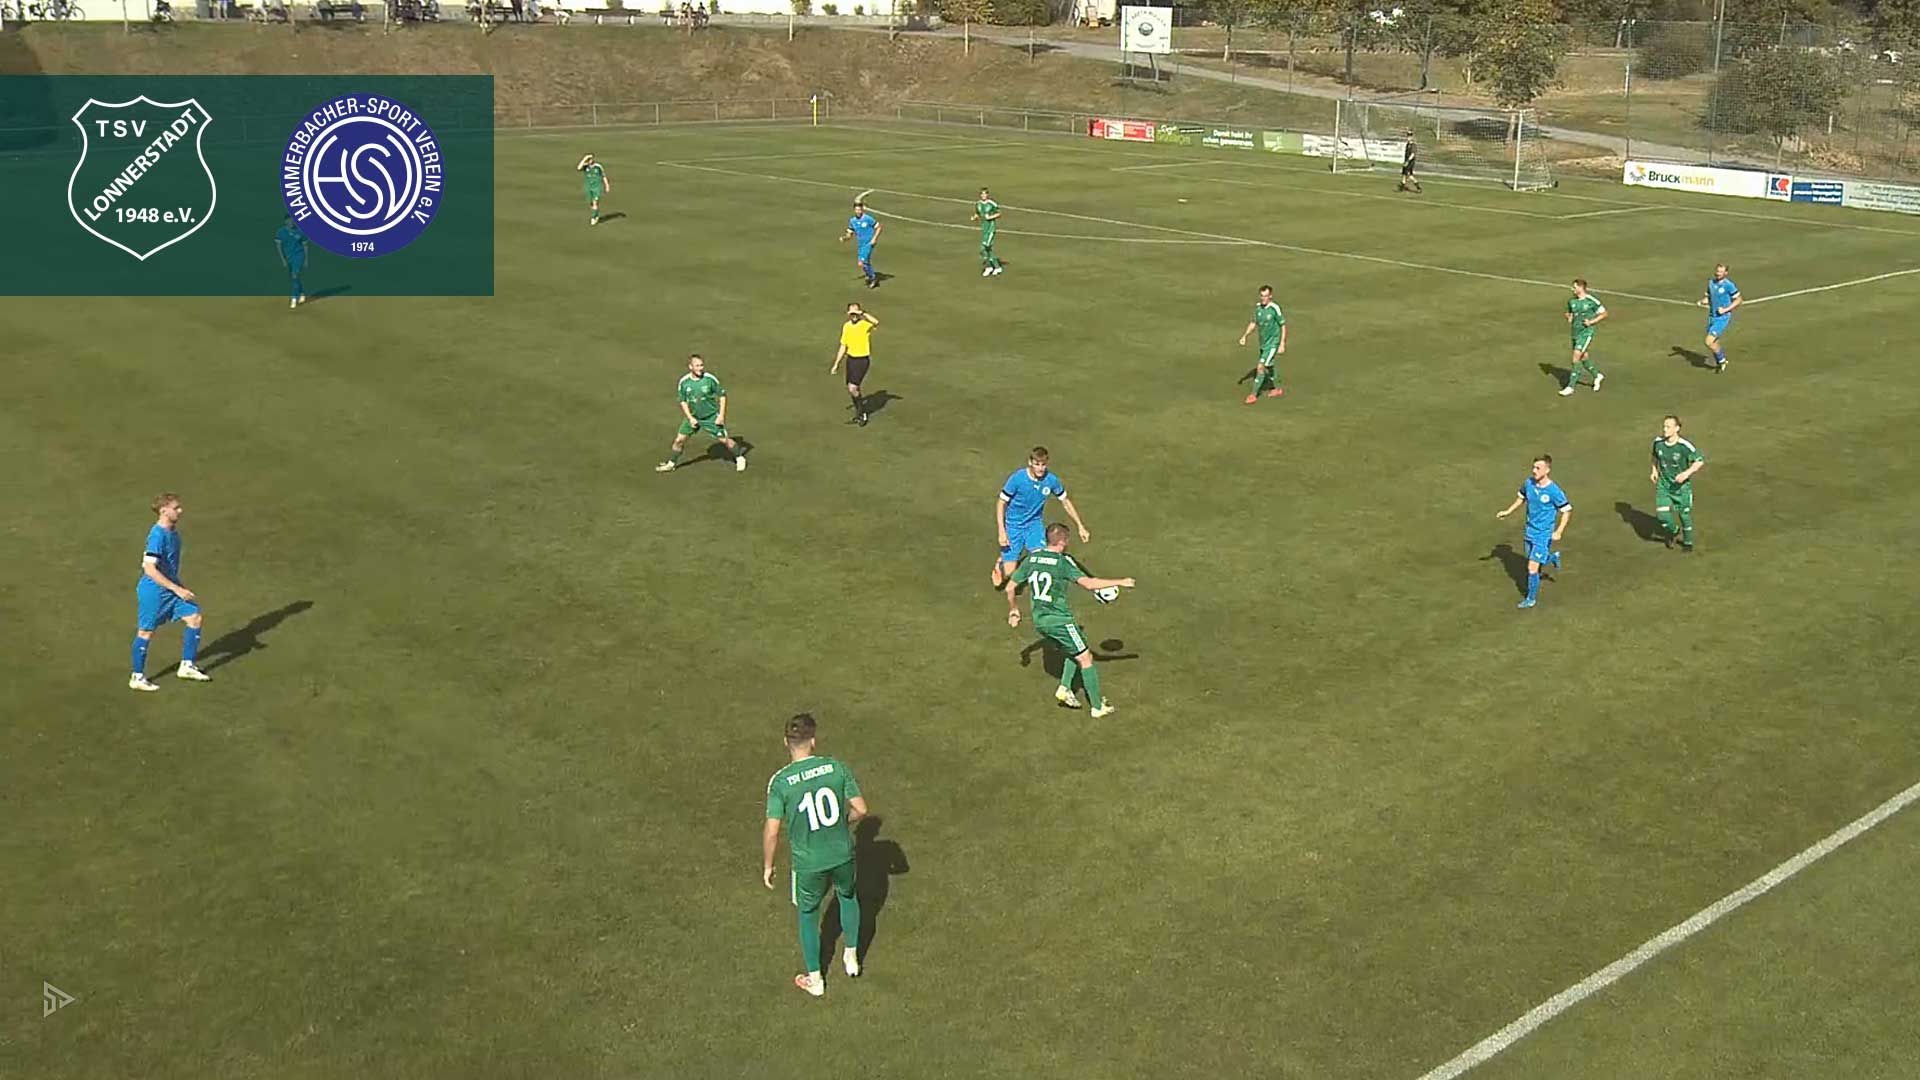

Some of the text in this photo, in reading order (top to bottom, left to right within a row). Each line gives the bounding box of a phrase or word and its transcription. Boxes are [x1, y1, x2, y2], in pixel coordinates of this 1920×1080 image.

[1648, 170, 1716, 187] Bruckmann
[1028, 570, 1053, 603] 12
[798, 786, 840, 831] 10
